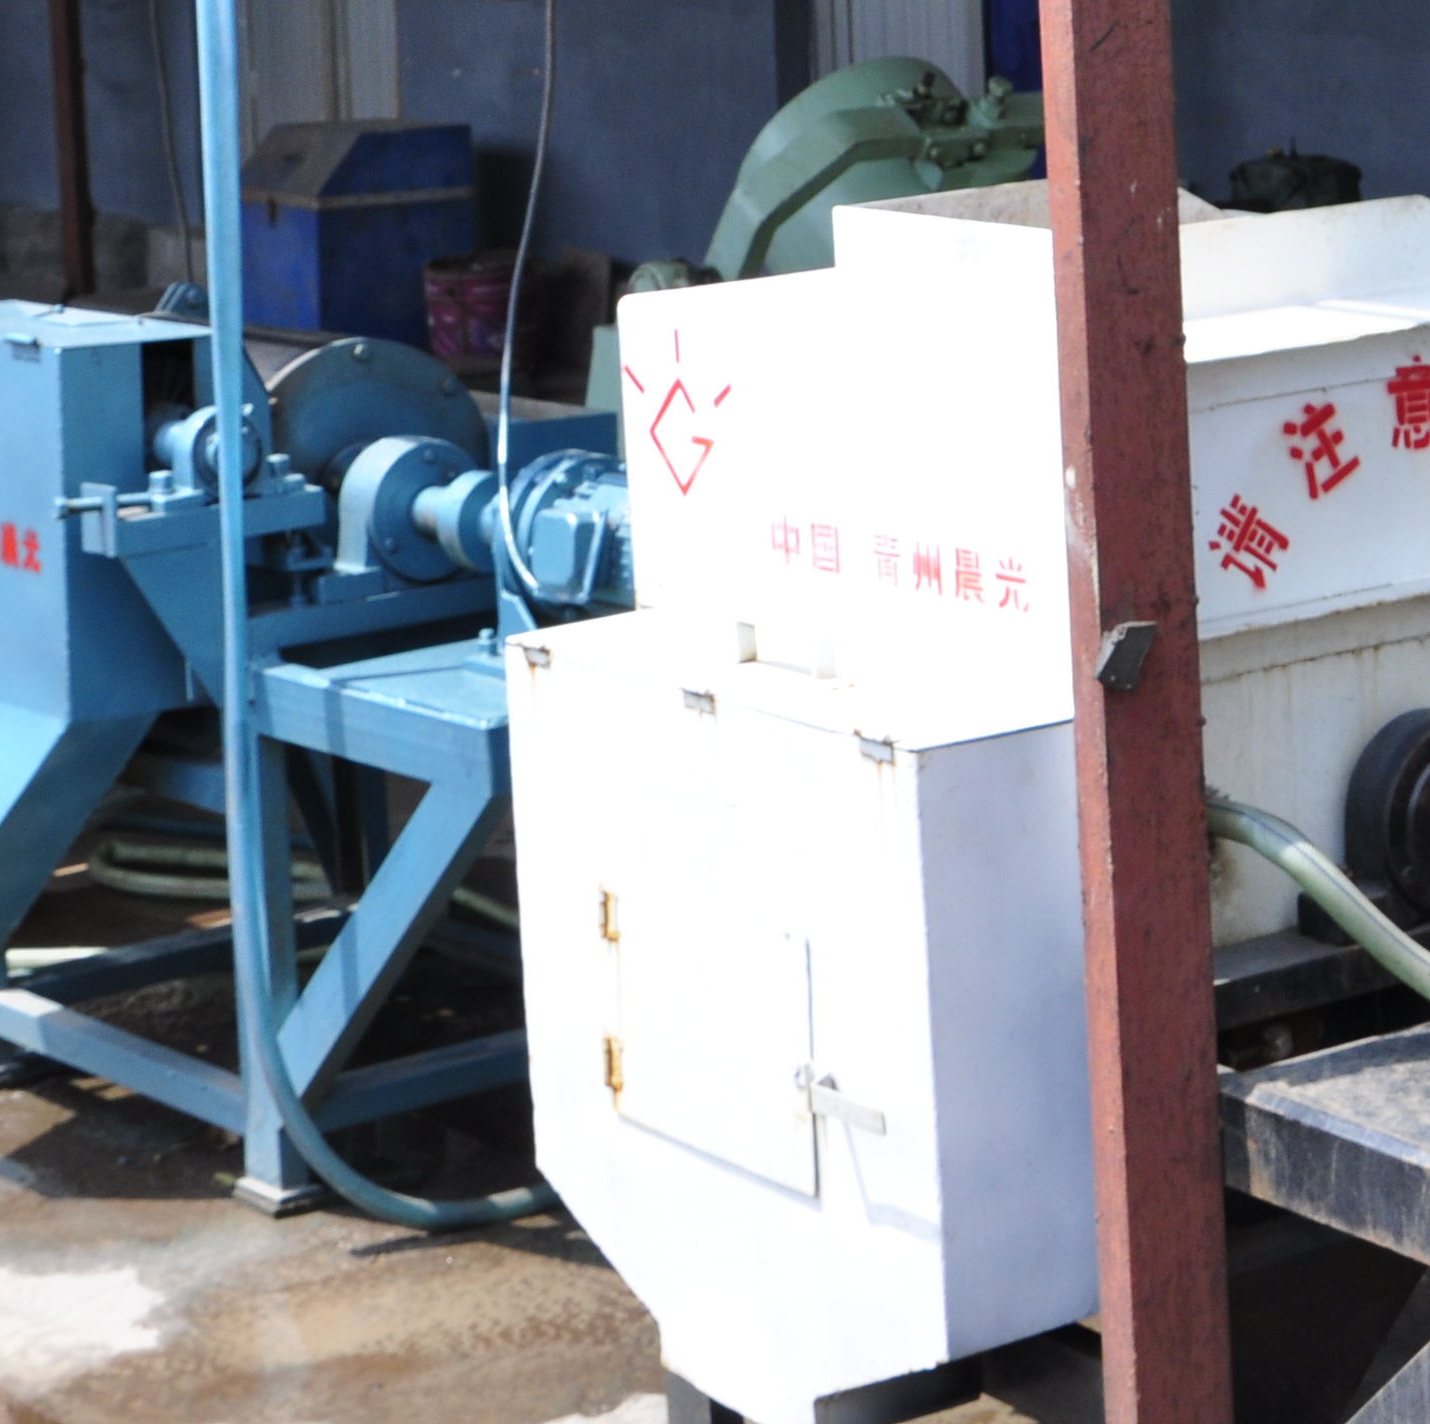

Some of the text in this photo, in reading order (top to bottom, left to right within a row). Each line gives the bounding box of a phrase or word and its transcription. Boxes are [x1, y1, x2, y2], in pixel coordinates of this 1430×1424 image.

[771, 516, 1031, 613] 中国 青州晨光
